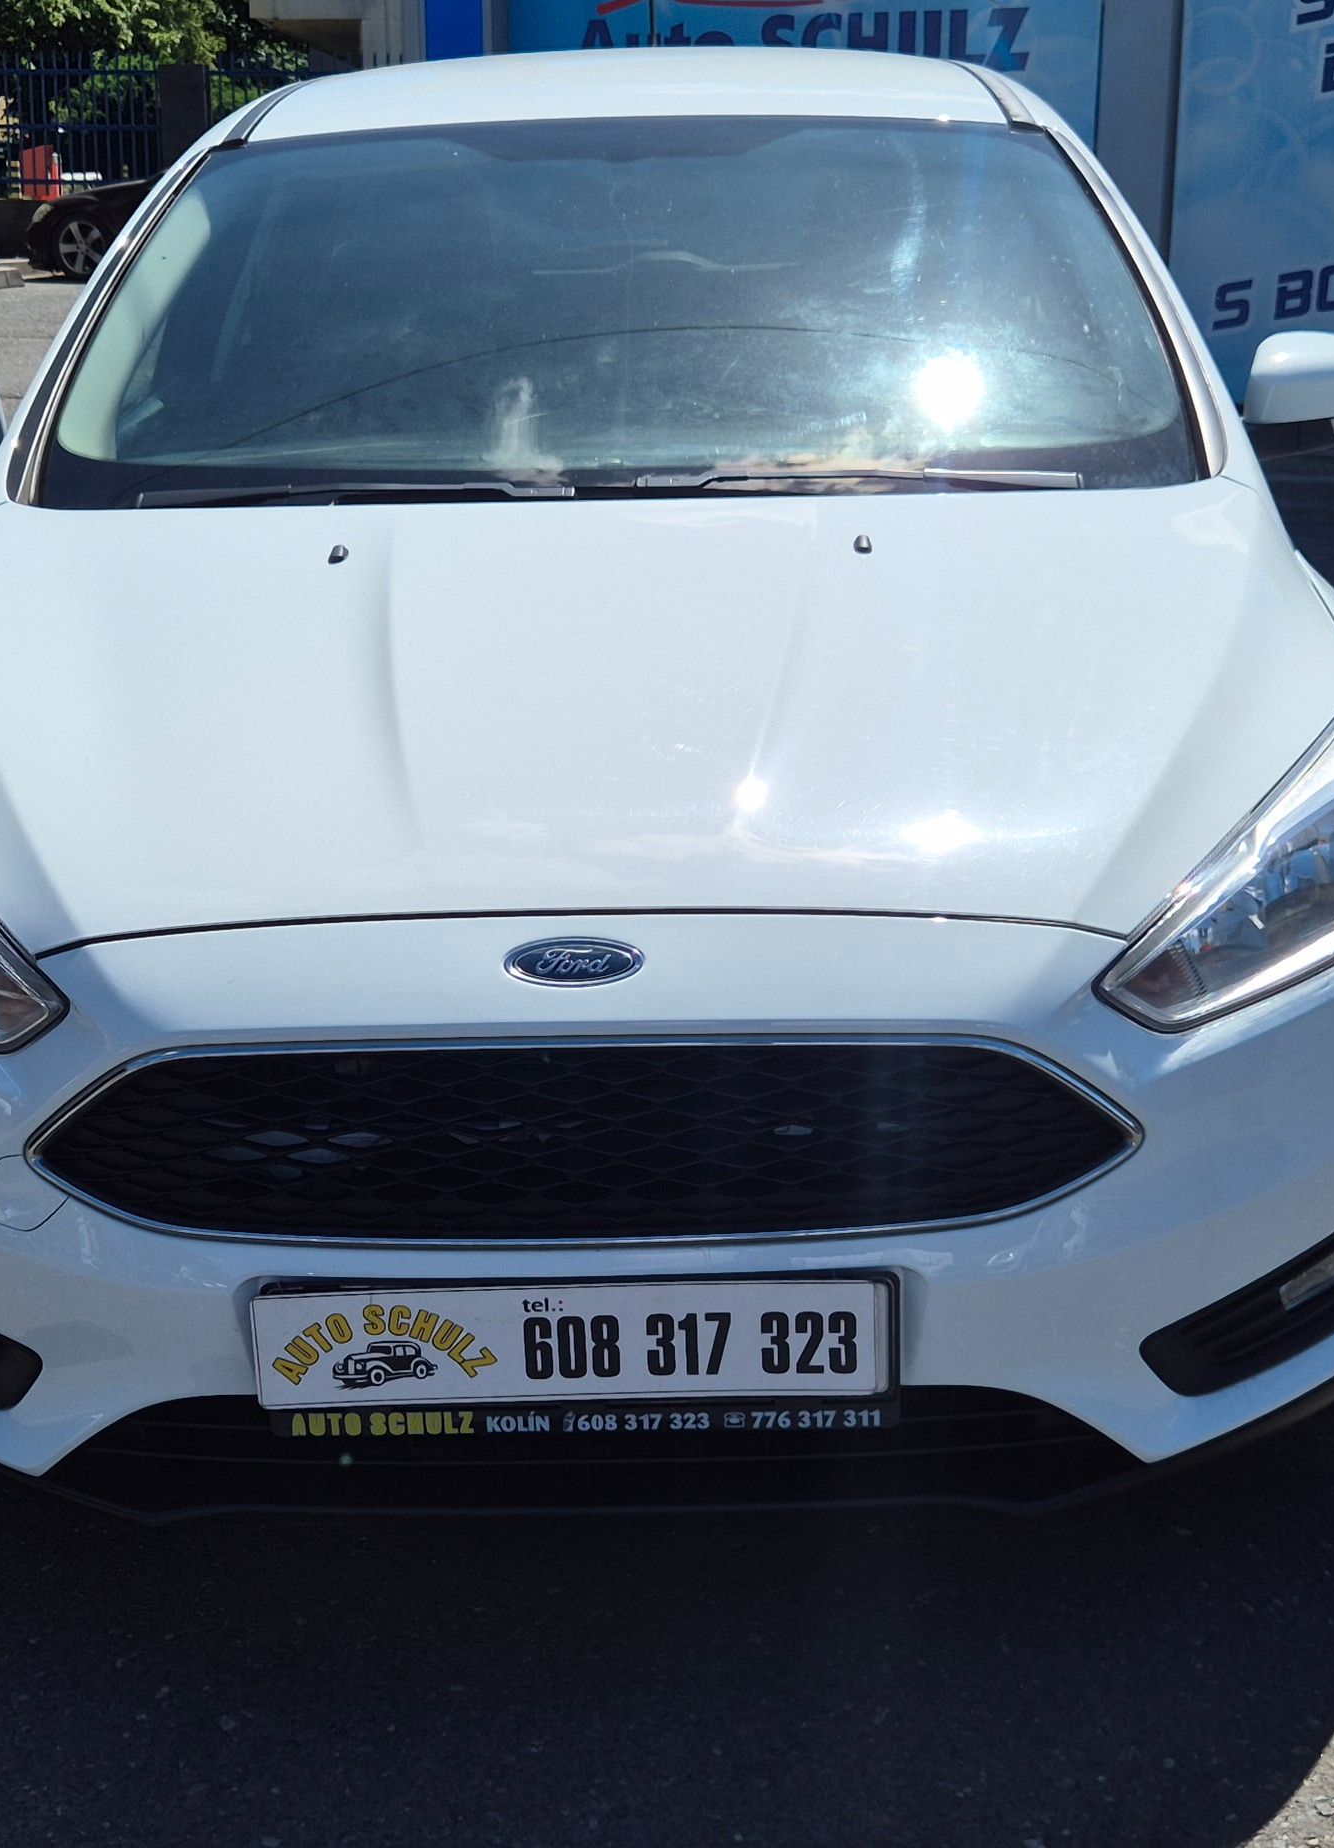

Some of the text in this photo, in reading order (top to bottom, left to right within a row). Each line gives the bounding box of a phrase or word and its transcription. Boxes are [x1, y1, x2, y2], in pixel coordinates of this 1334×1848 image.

[1212, 279, 1253, 331] S
[536, 948, 611, 974] Ford
[522, 1298, 564, 1312] tel.:
[272, 1304, 498, 1385] AUTO SCHULZ
[523, 1311, 858, 1379] 608 317 323
[292, 1409, 881, 1437] AUTO SCHULZ KOLÍN 608 317 323 776 317 311
